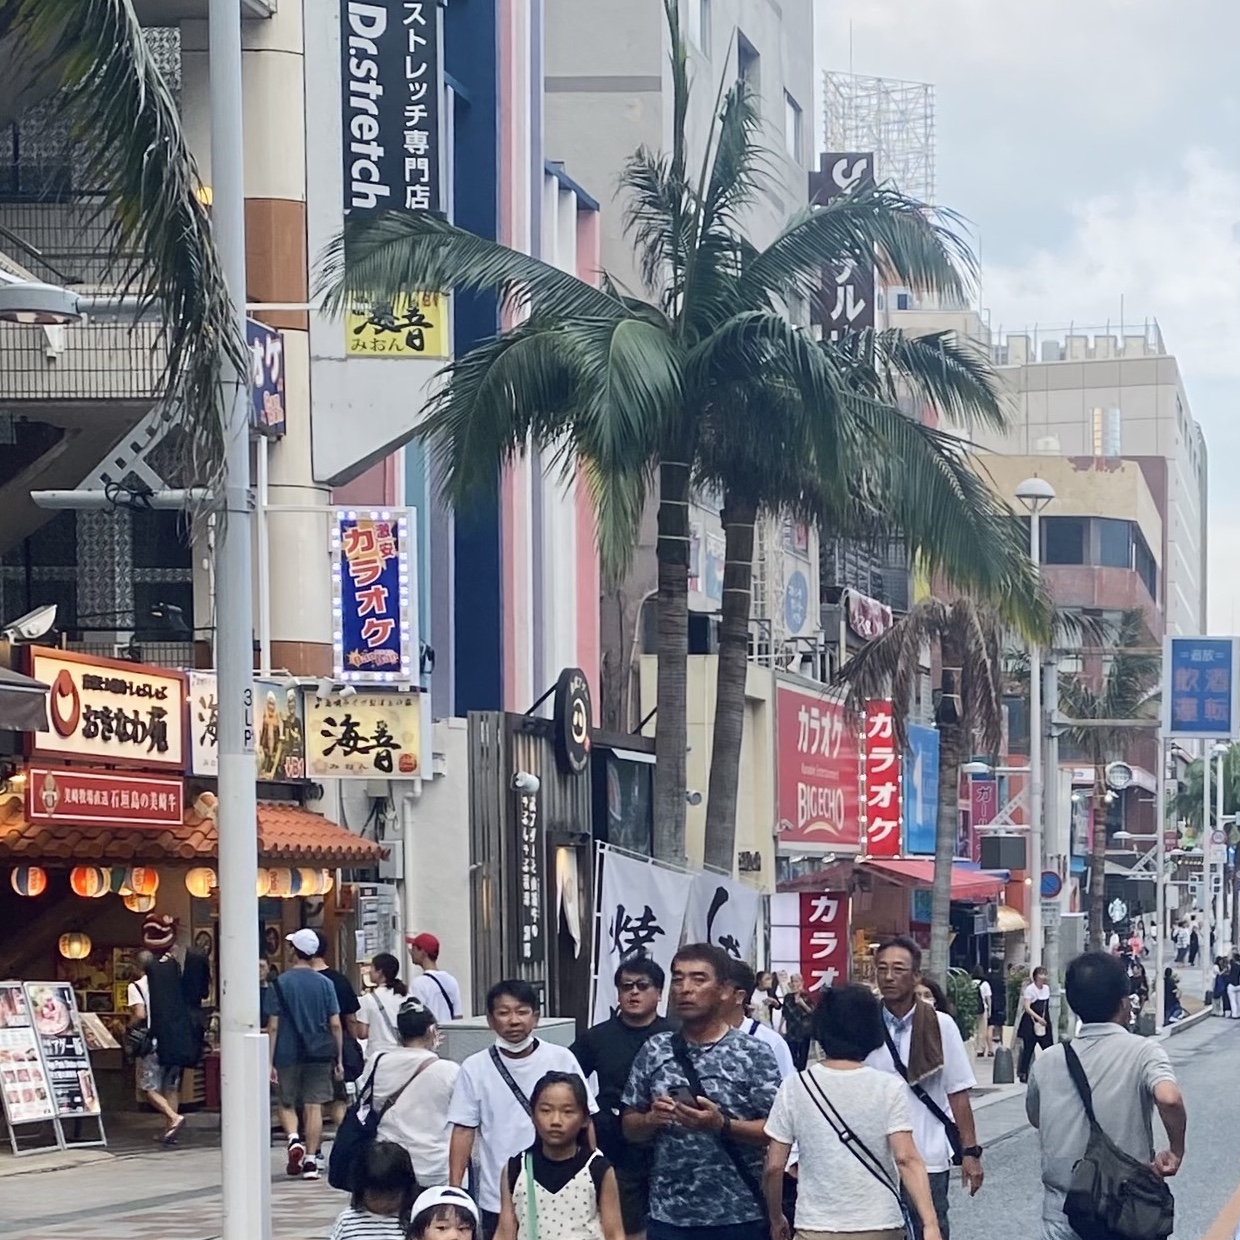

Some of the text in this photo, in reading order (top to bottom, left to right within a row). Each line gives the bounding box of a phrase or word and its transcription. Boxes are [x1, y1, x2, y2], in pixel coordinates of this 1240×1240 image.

[348, 2, 390, 209] Dr.stretch
[402, 3, 430, 210] ストレッチ専門店
[351, 338, 405, 352] みおん
[342, 527, 395, 648] カラオケ
[320, 713, 402, 773] 海音
[797, 704, 843, 759] カラオケ
[867, 712, 898, 842] カラオケ
[808, 895, 840, 992] カラオ
